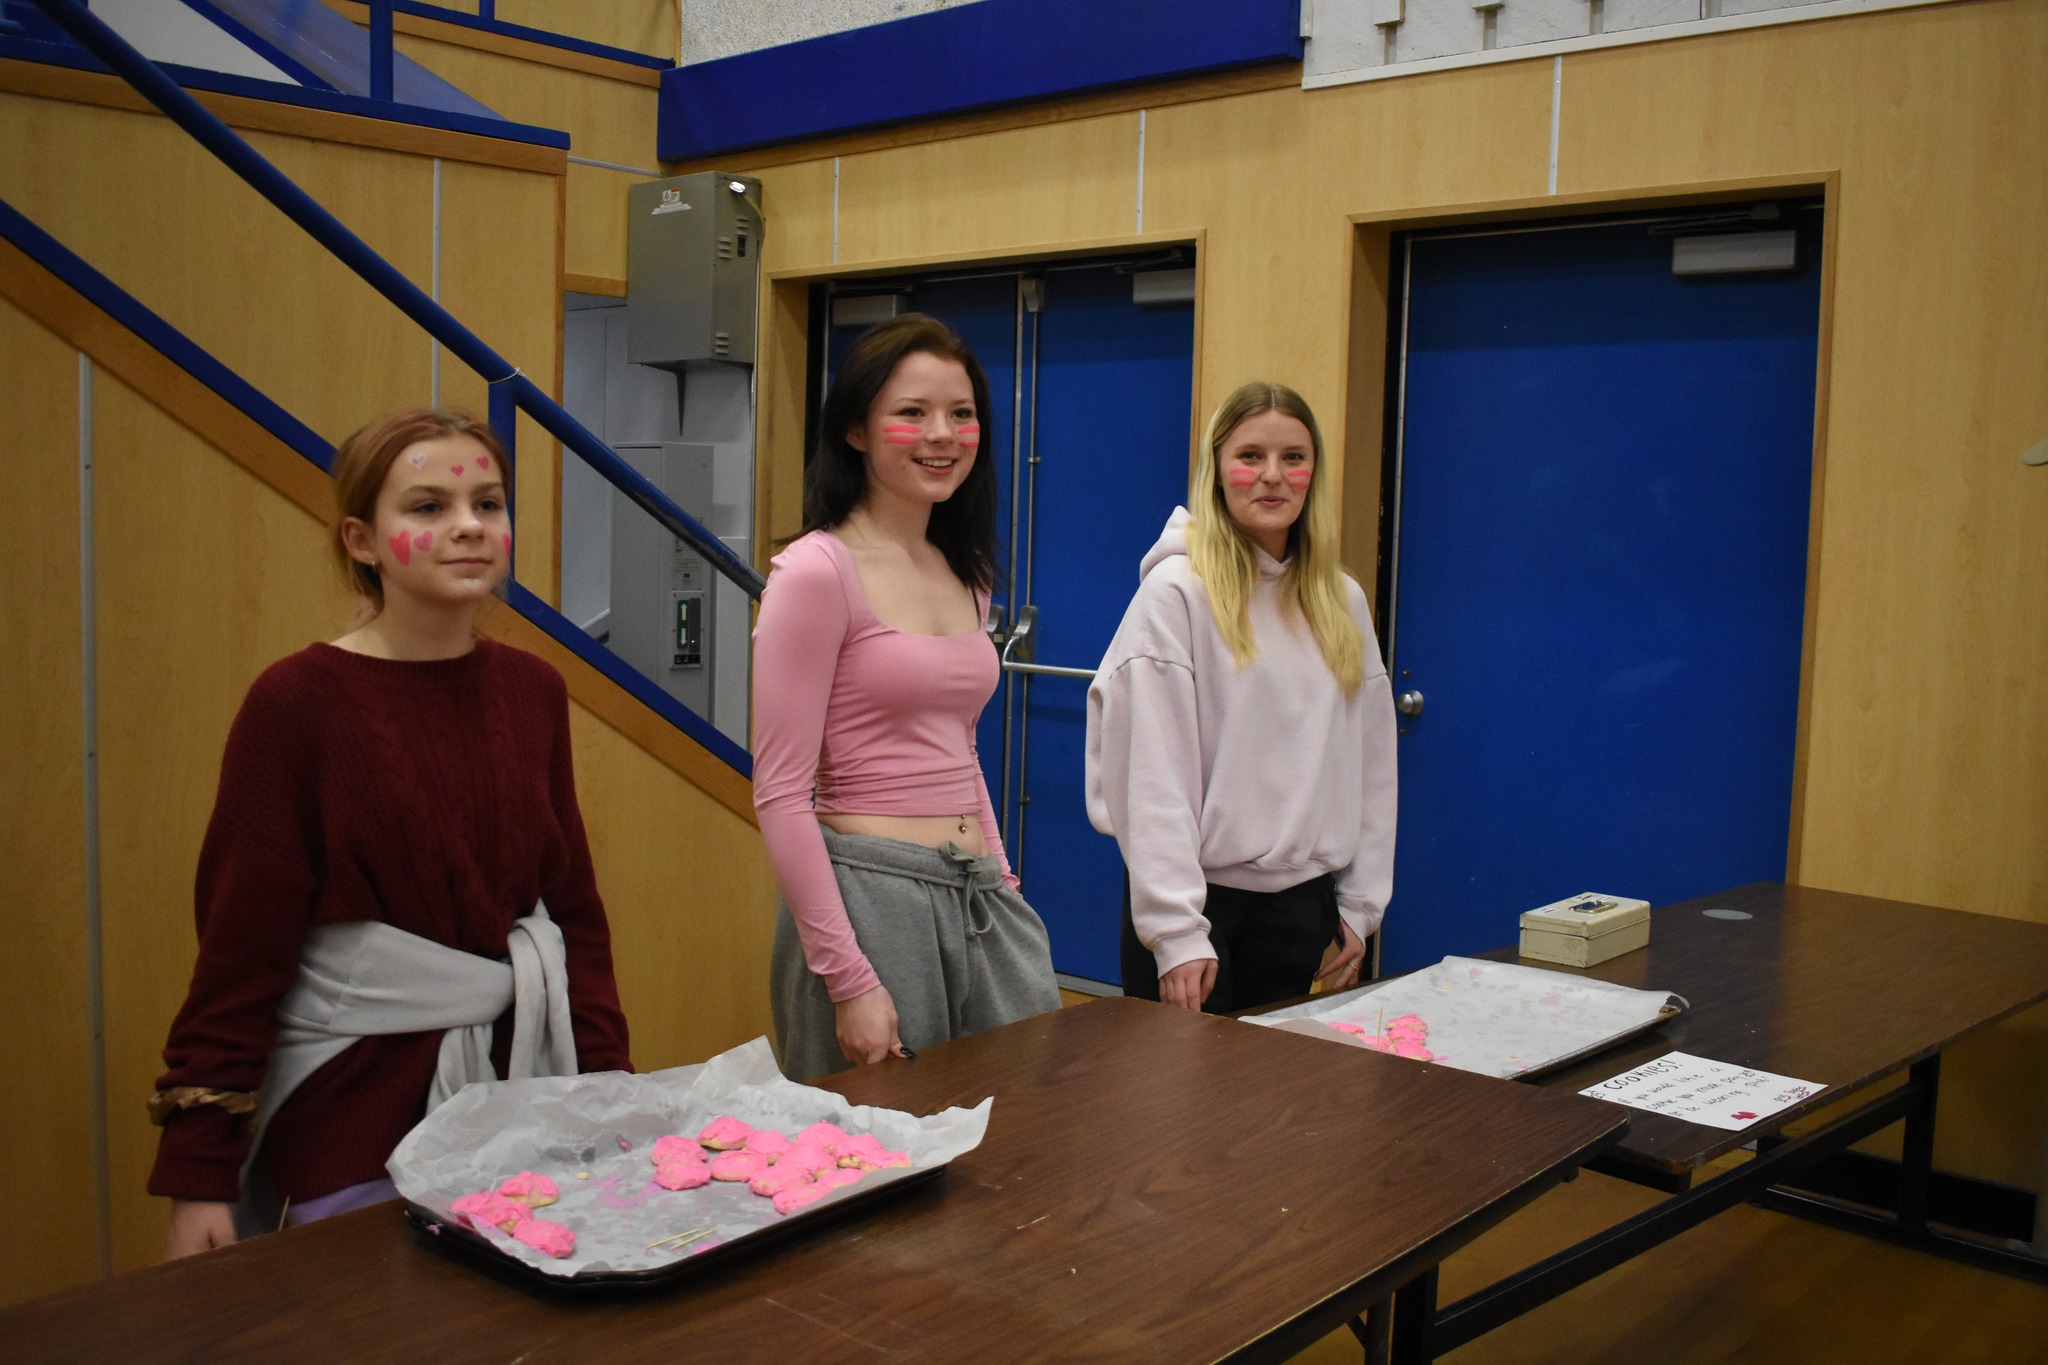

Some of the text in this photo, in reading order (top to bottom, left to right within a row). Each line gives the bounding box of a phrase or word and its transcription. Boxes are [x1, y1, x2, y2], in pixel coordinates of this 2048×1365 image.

[1633, 1093, 1650, 1101] you
[1647, 1082, 1677, 1093] would
[1673, 1073, 1704, 1083] like
[1676, 1093, 1694, 1101] you
[1695, 1082, 1723, 1093] must
[1720, 1075, 1749, 1084] pay
[1701, 1089, 1751, 1105] wearing
